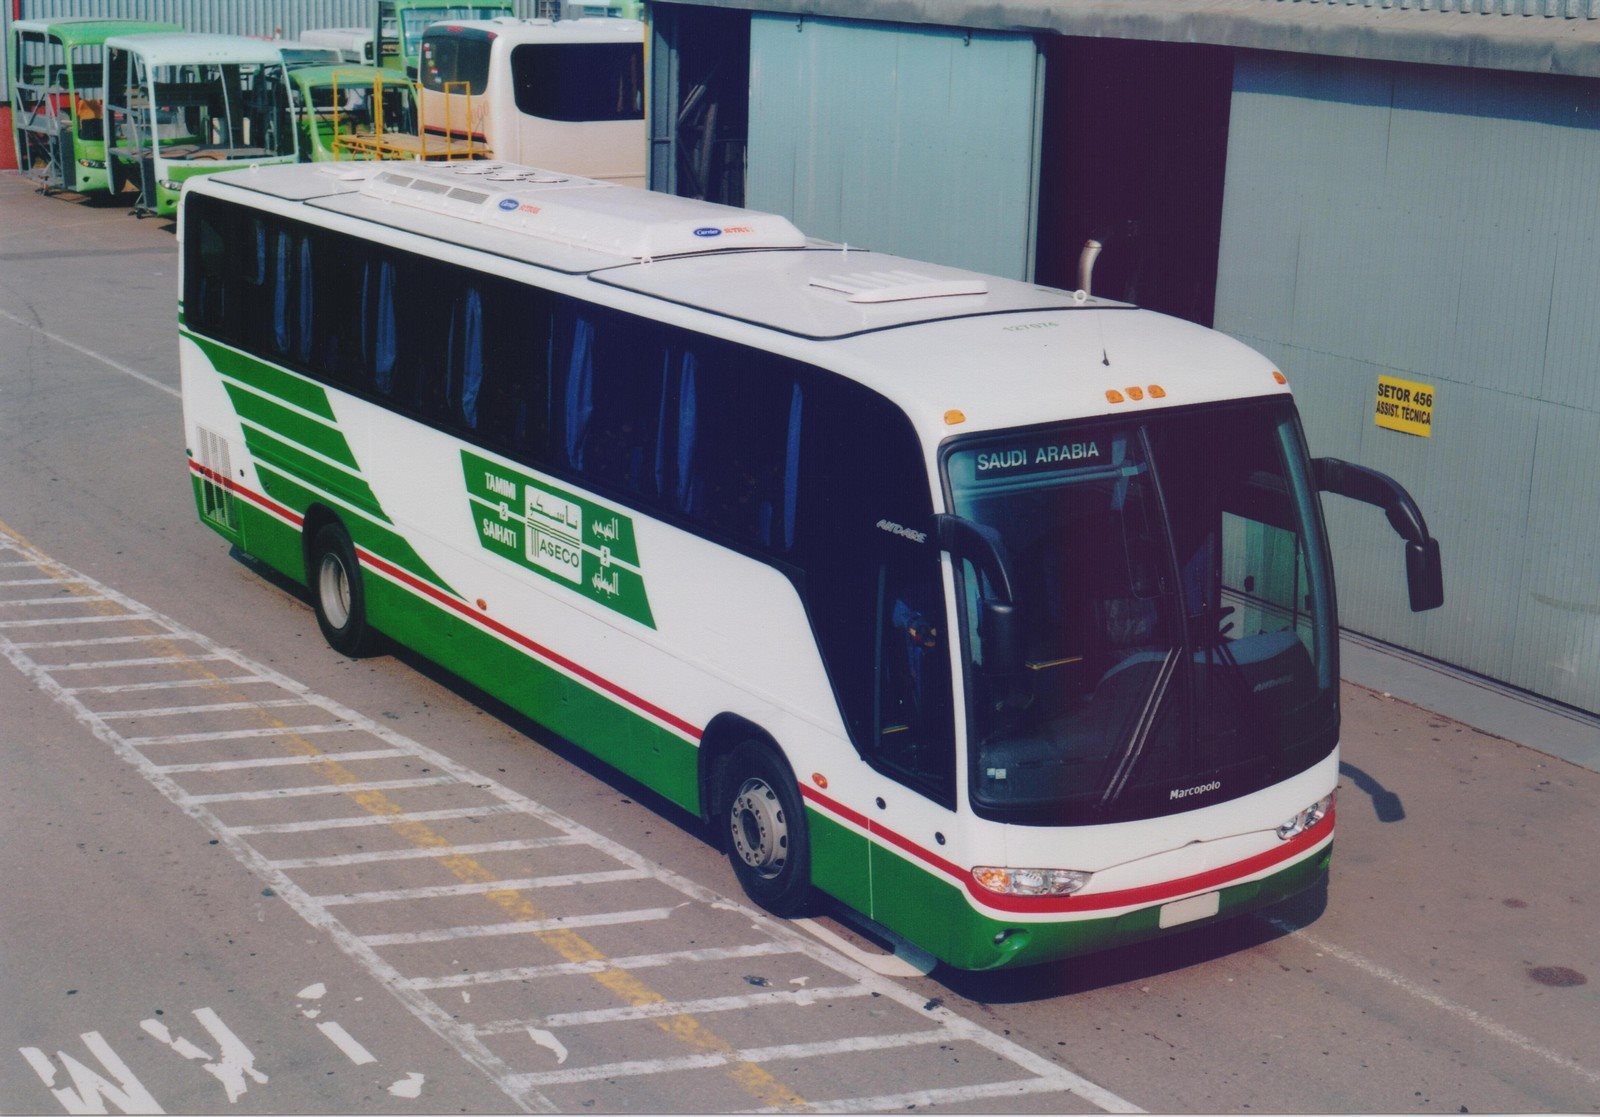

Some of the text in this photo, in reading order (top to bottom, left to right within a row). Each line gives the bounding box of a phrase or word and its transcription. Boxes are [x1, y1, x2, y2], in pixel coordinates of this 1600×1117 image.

[1378, 383, 1433, 408] SETOR 456
[1401, 406, 1431, 426] TECNICA
[977, 441, 1099, 471] SAUDI ARABIA
[484, 472, 516, 501] TAMIMI
[482, 518, 517, 549] SAIHATI
[1169, 781, 1221, 800] Marcopolo
